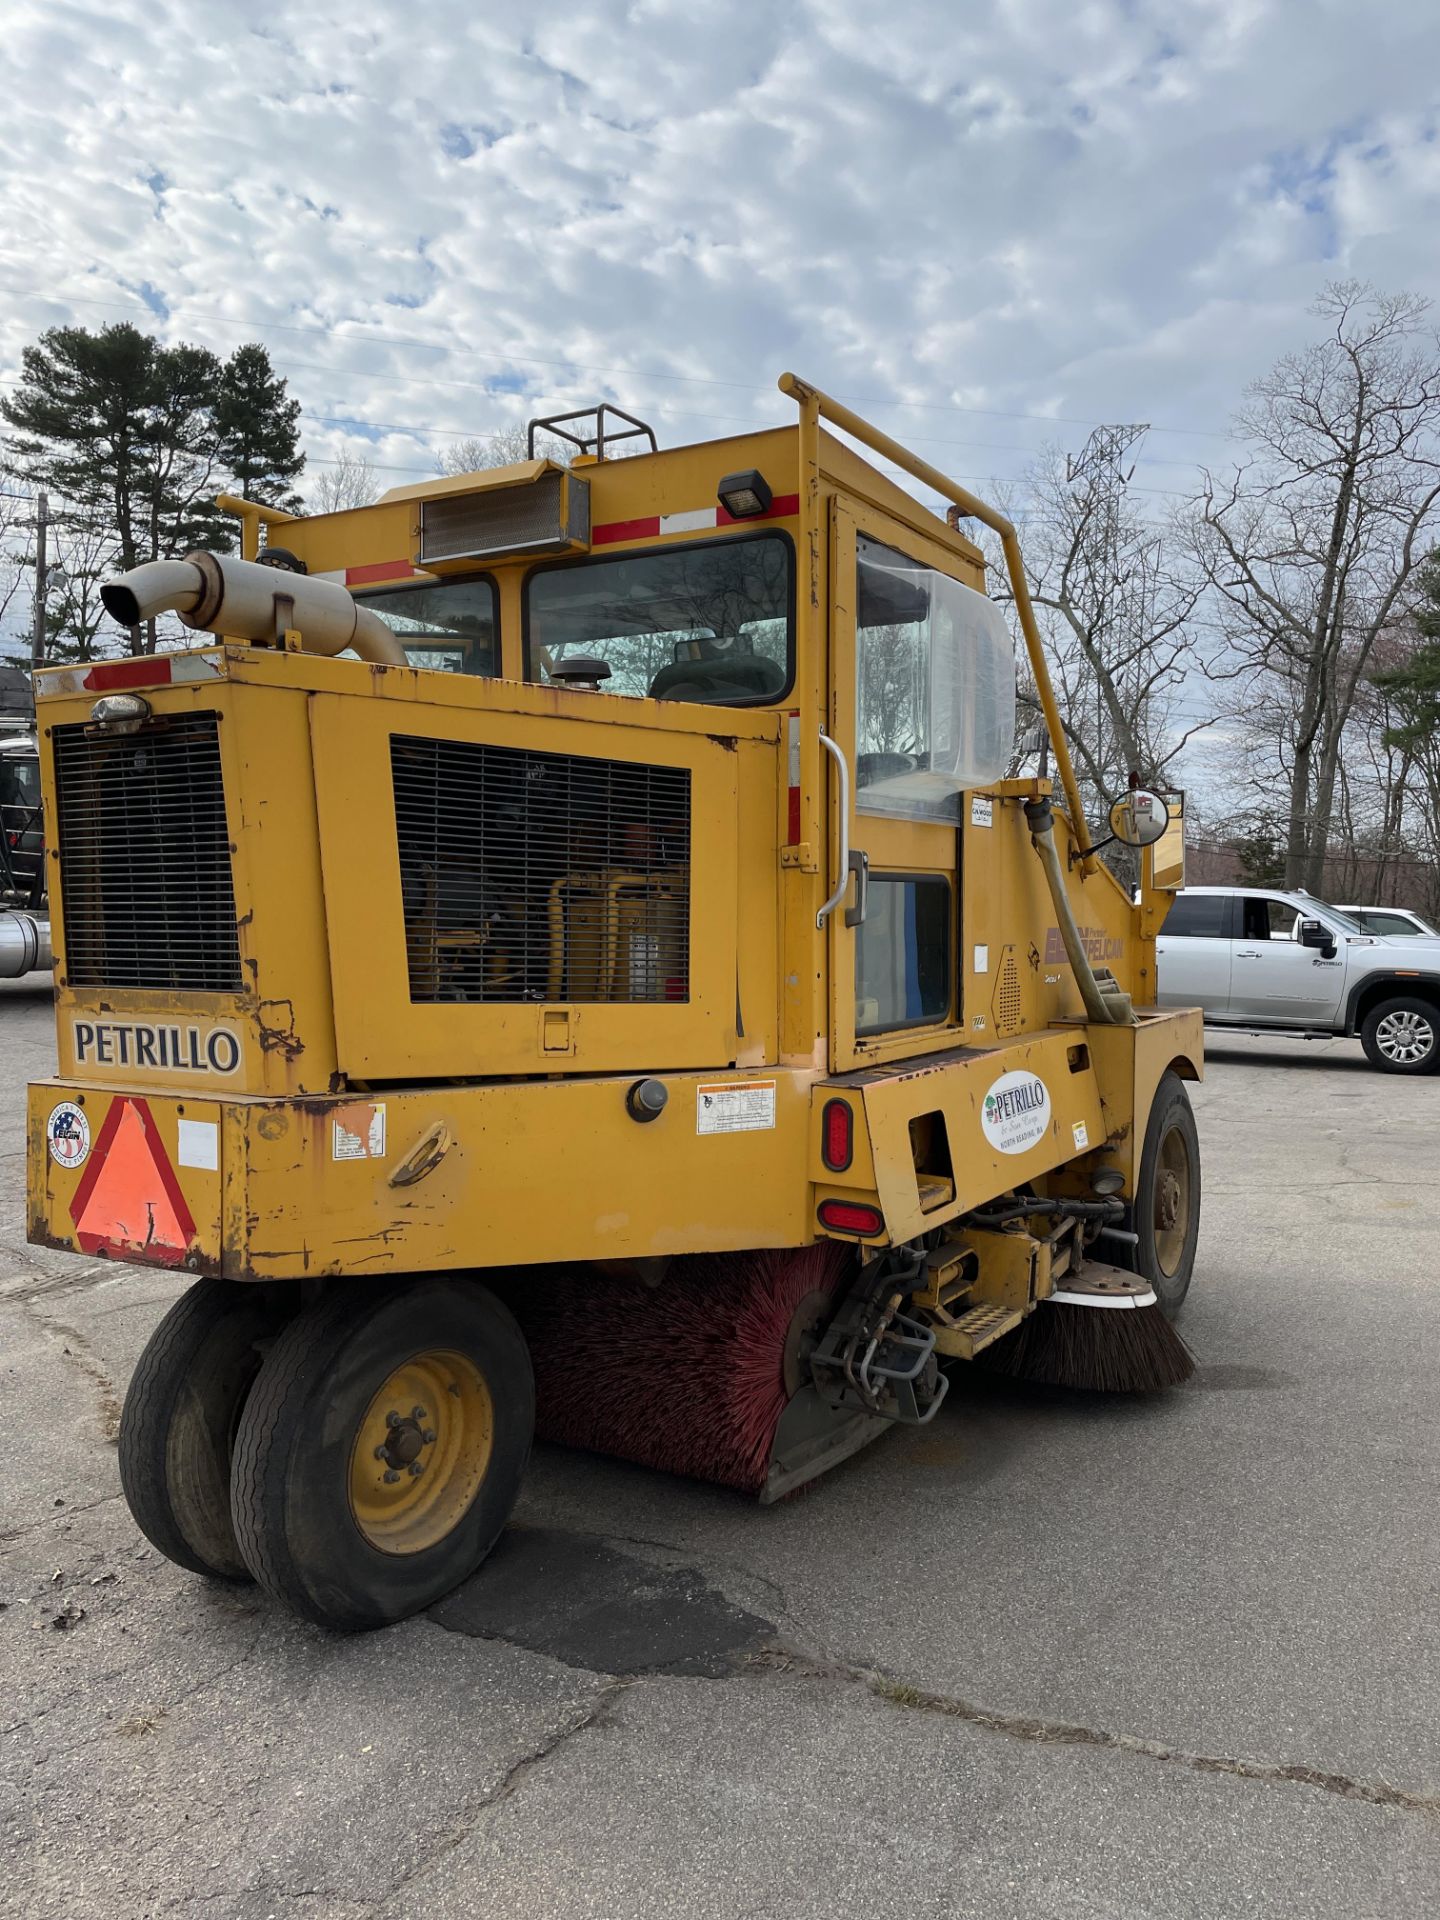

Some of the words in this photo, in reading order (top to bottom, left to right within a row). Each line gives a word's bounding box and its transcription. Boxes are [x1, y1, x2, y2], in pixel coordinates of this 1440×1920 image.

[1088, 938, 1124, 961] PELICAN
[75, 1022, 240, 1074] PETRILLO
[996, 1081, 1044, 1120] PETRILLO
[58, 1129, 81, 1140] ELGIN
[1000, 1136, 1016, 1150] NORTH
